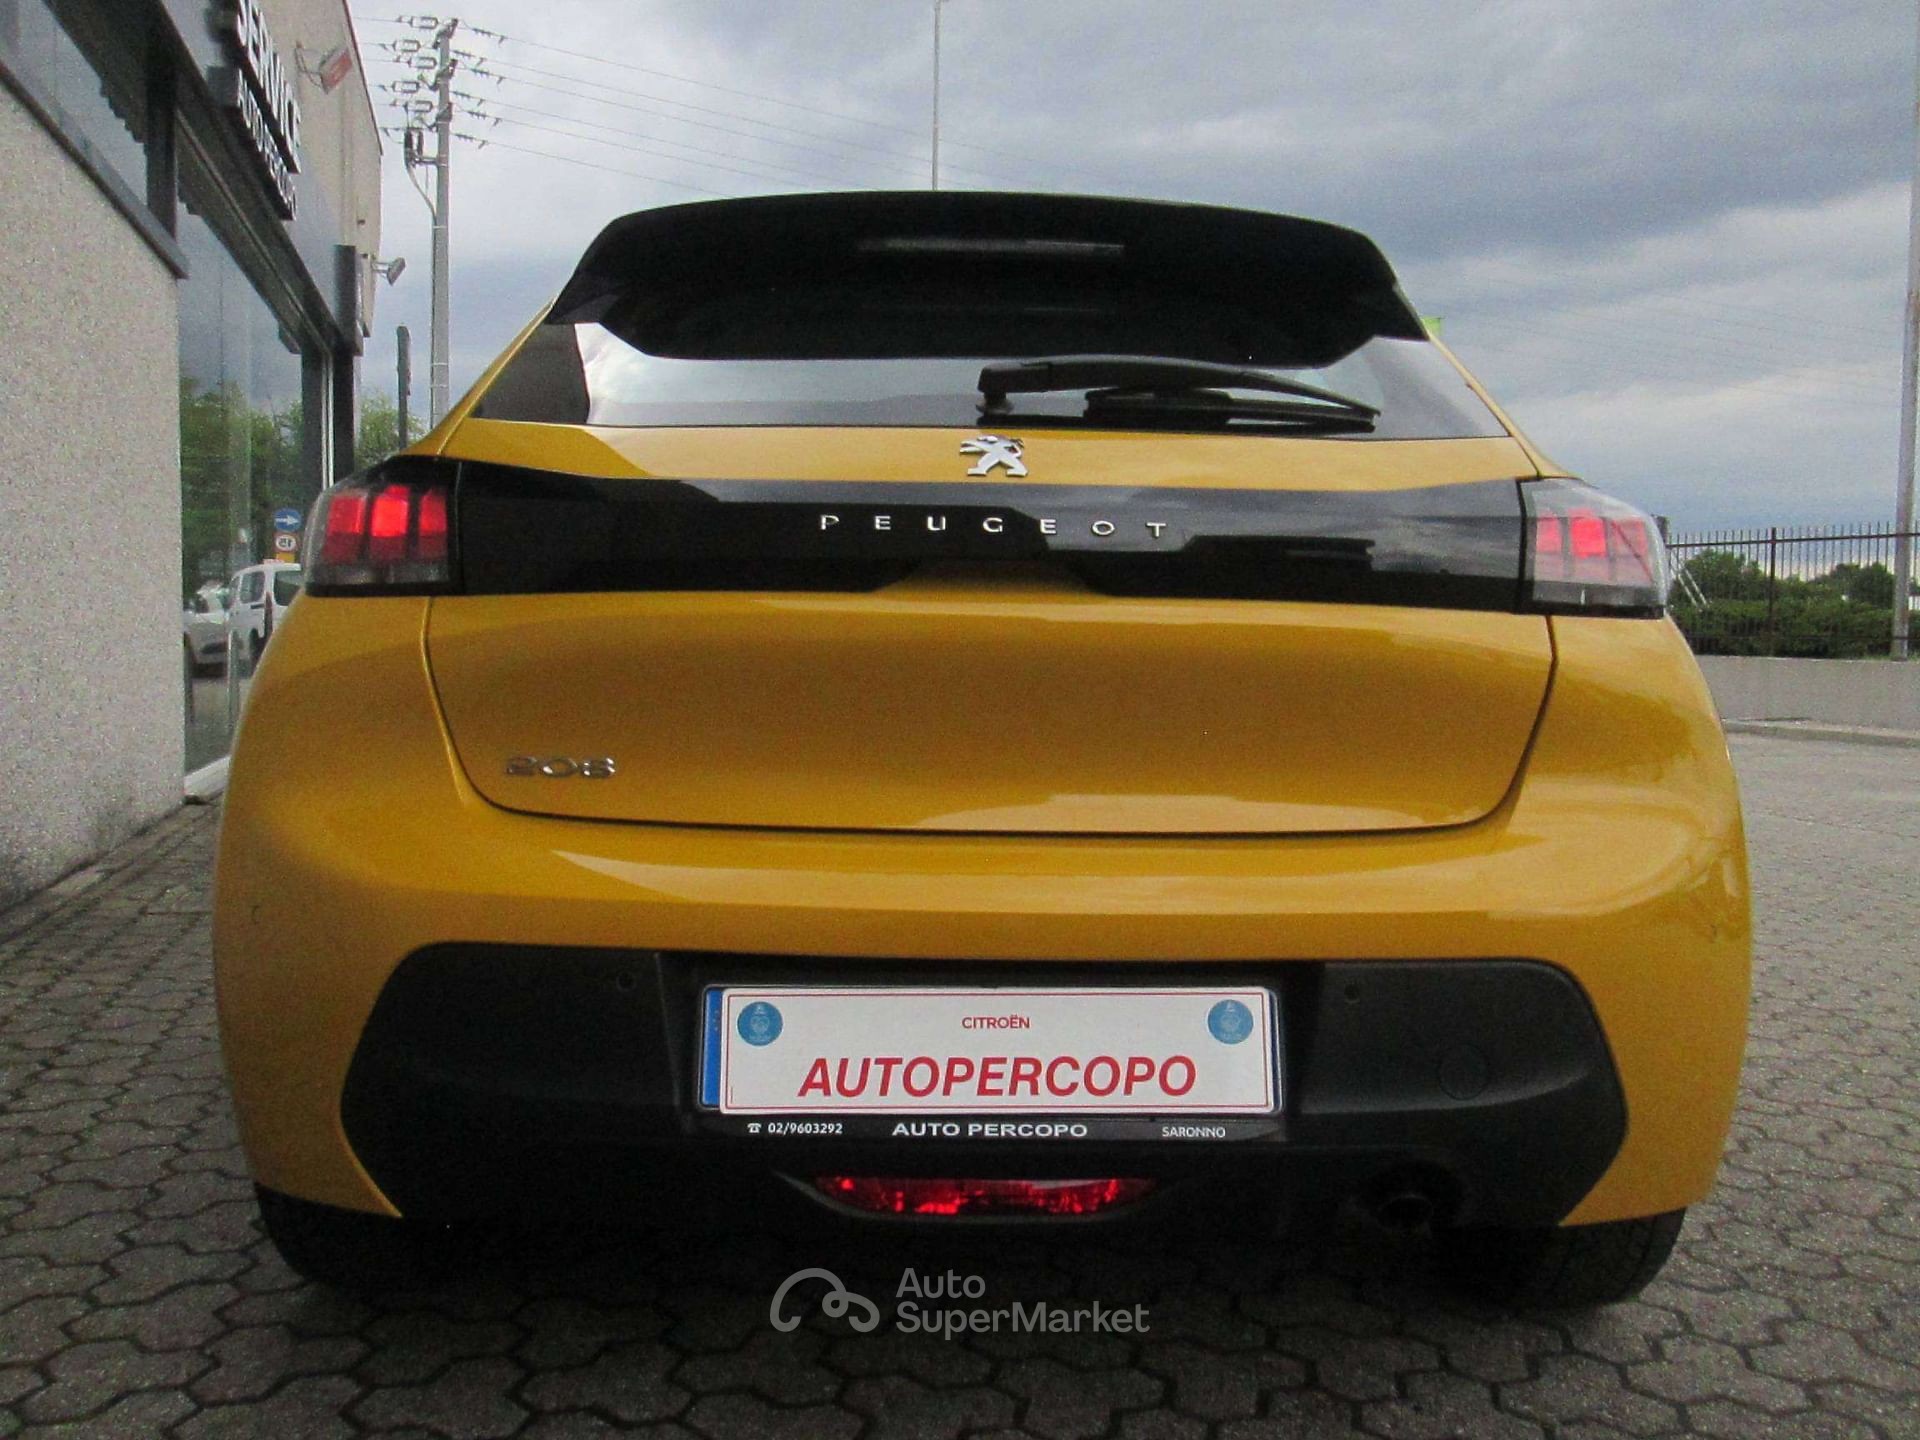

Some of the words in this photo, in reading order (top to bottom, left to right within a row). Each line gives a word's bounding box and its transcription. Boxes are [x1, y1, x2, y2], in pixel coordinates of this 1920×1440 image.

[820, 514, 1167, 538] PEUGEOT
[506, 756, 616, 777] 208
[961, 1014, 1031, 1029] CITROËN
[797, 1055, 1196, 1097] AUTOPERCOPO
[767, 1122, 843, 1135] 02/9603292
[892, 1123, 960, 1136] AUTO
[967, 1124, 1088, 1137] PERCOPO
[1162, 1126, 1226, 1138] SARONNO
